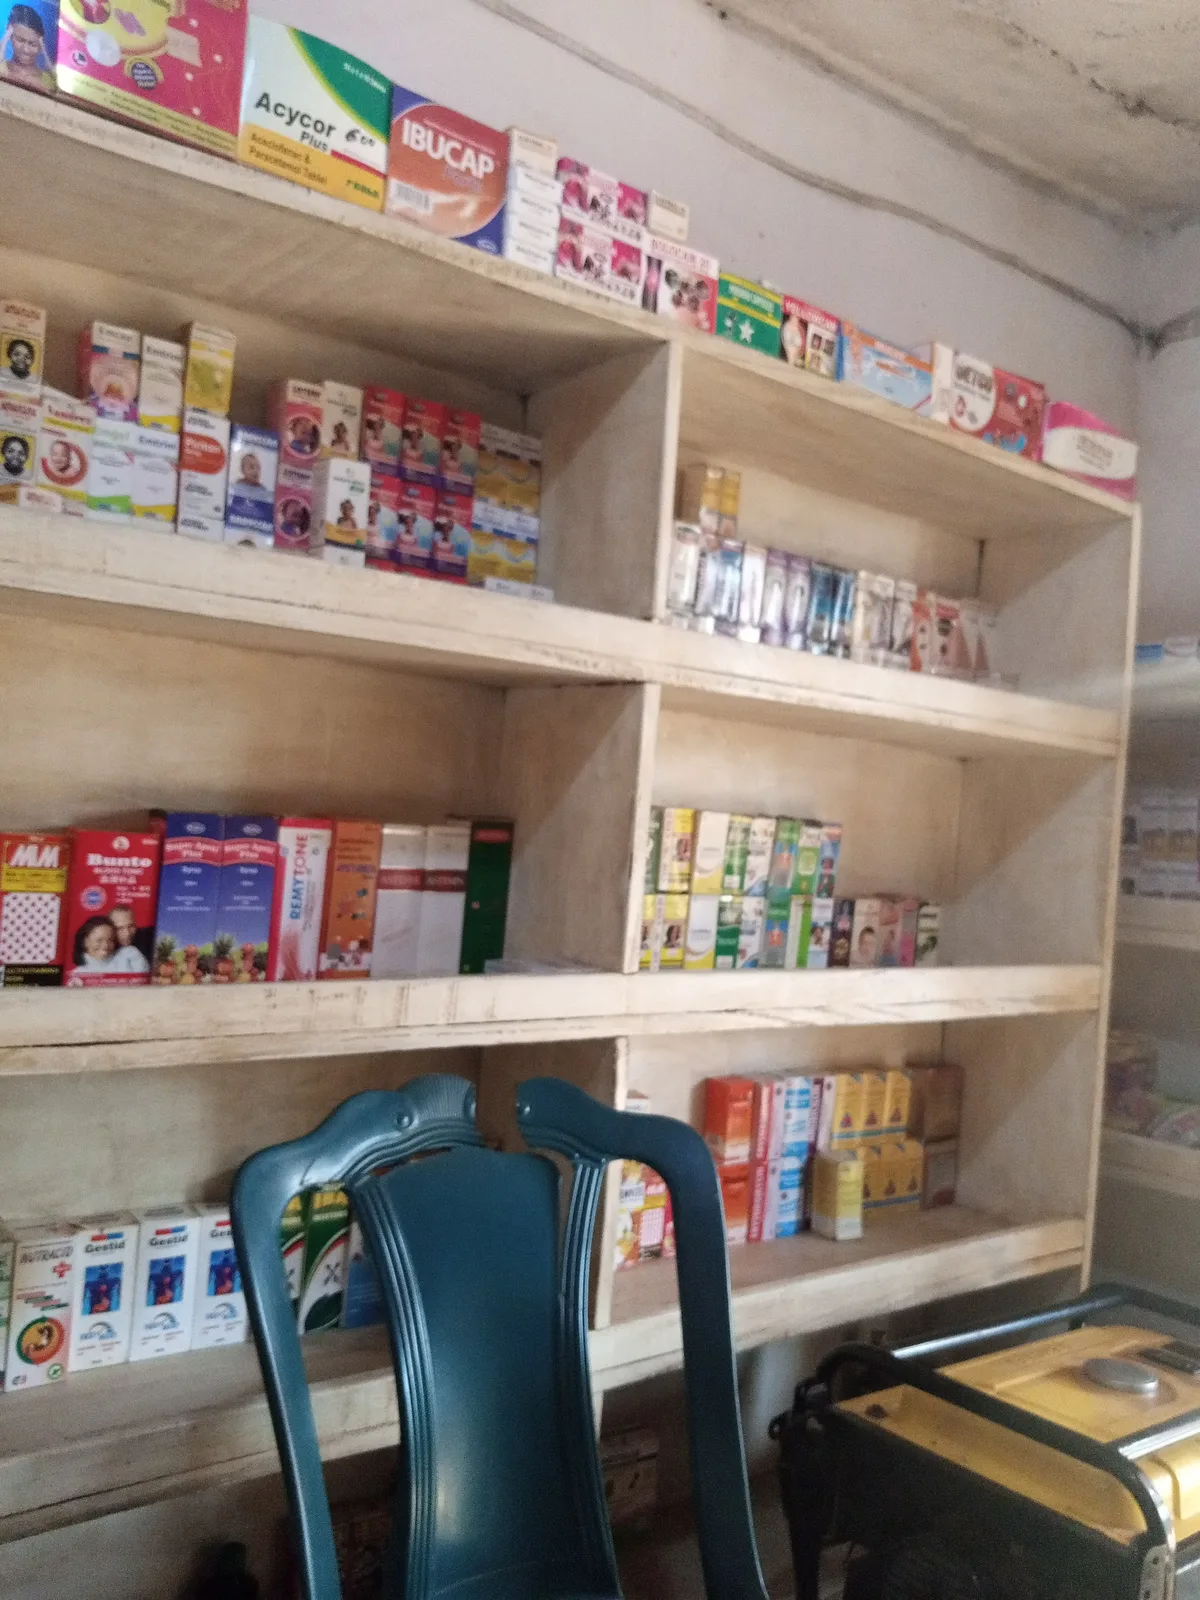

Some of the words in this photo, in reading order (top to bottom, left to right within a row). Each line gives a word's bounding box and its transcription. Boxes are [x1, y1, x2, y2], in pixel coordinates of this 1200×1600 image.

[255, 91, 337, 138] Acycor
[300, 130, 329, 152] Plus
[402, 118, 495, 179] IBUCAP
[149, 1234, 188, 1248] Gestid
[210, 1229, 232, 1239] Ges
[85, 1240, 125, 1254] Gestid
